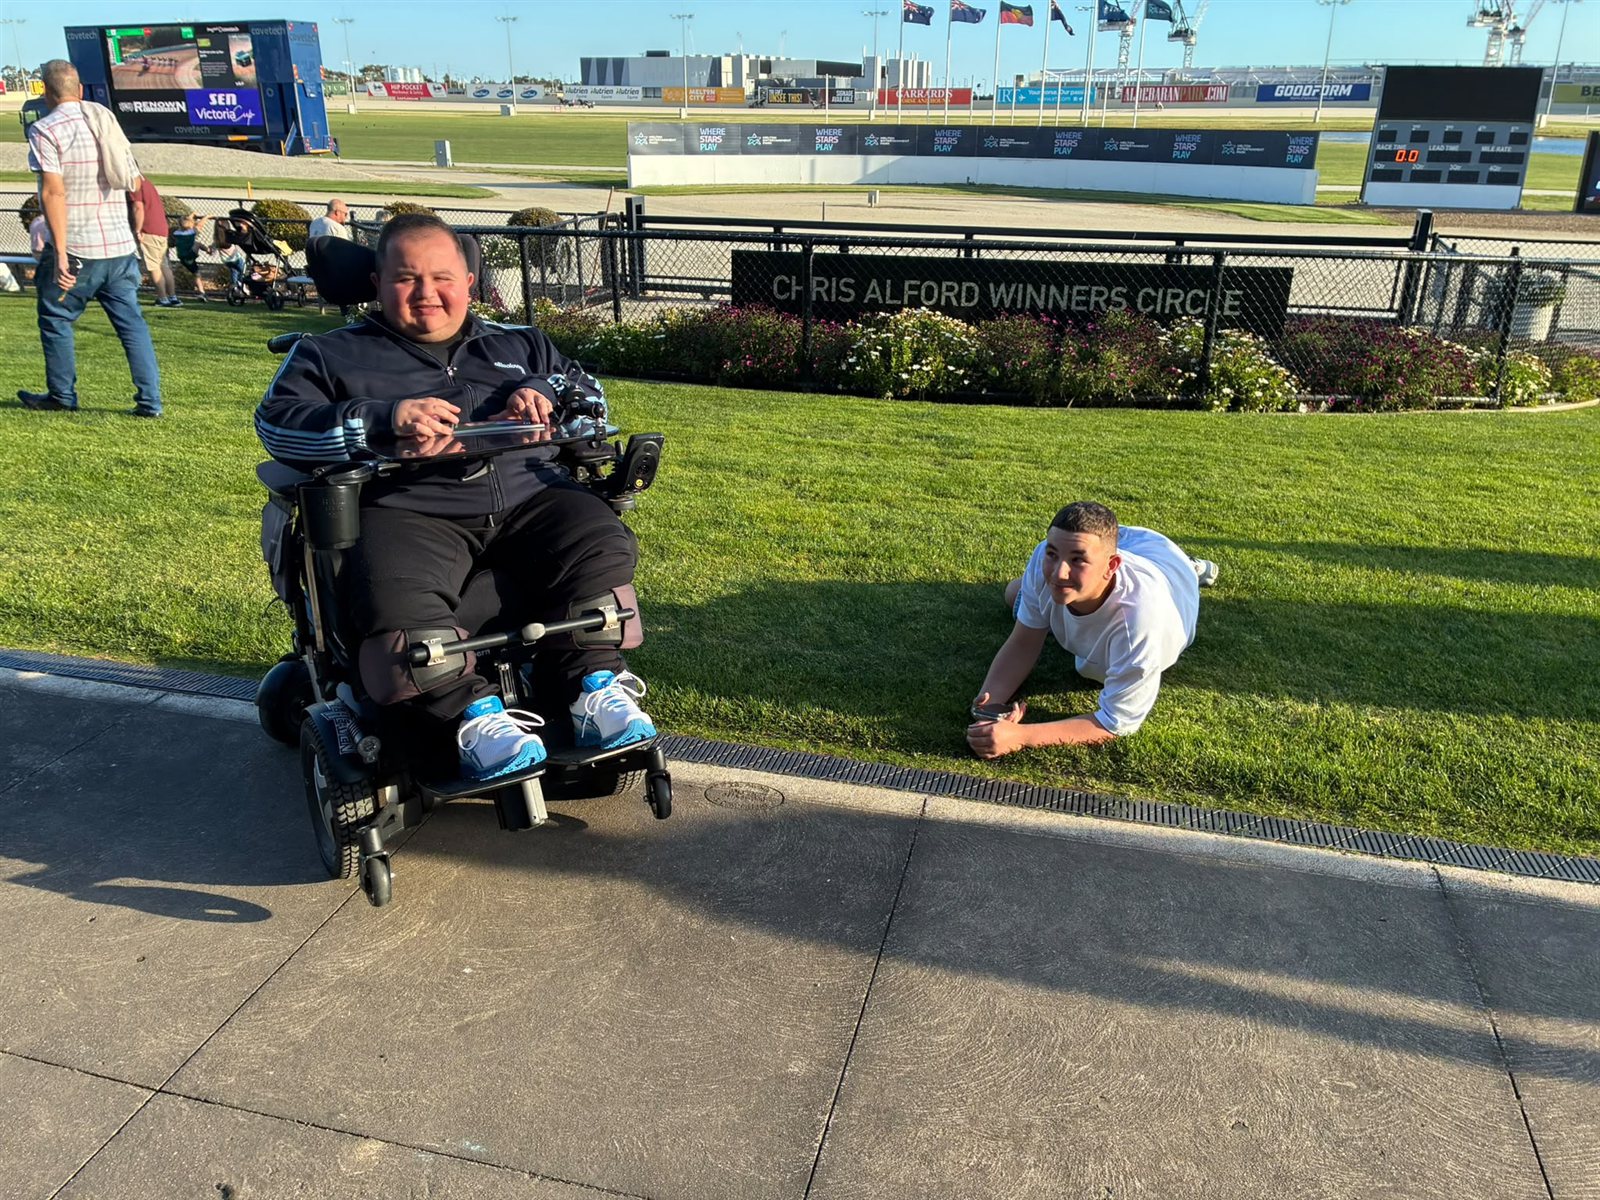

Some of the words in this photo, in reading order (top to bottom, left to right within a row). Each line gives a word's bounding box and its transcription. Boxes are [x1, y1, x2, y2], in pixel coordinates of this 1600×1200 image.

[251, 25, 286, 36] covetech
[67, 31, 97, 40] covetech
[1274, 84, 1353, 96] GOODFORM
[208, 93, 237, 106] SEN
[133, 101, 187, 112] RENOWN
[195, 108, 236, 120] Victoria
[231, 105, 255, 126] Cup
[174, 126, 210, 134] covetech
[816, 128, 842, 136] WHERE
[1175, 134, 1201, 142] WHERE
[1289, 137, 1314, 145] WHERE
[1054, 147, 1072, 155] PLAY
[1174, 143, 1197, 151] STARS
[1288, 145, 1309, 154] STARS
[1286, 154, 1303, 163] PLAY
[1395, 149, 1420, 163] 0.0
[772, 274, 855, 302] CHRIS
[864, 278, 980, 307] ALFORD
[988, 282, 1128, 312] WINNERS
[1136, 287, 1244, 316] CIRCLE
